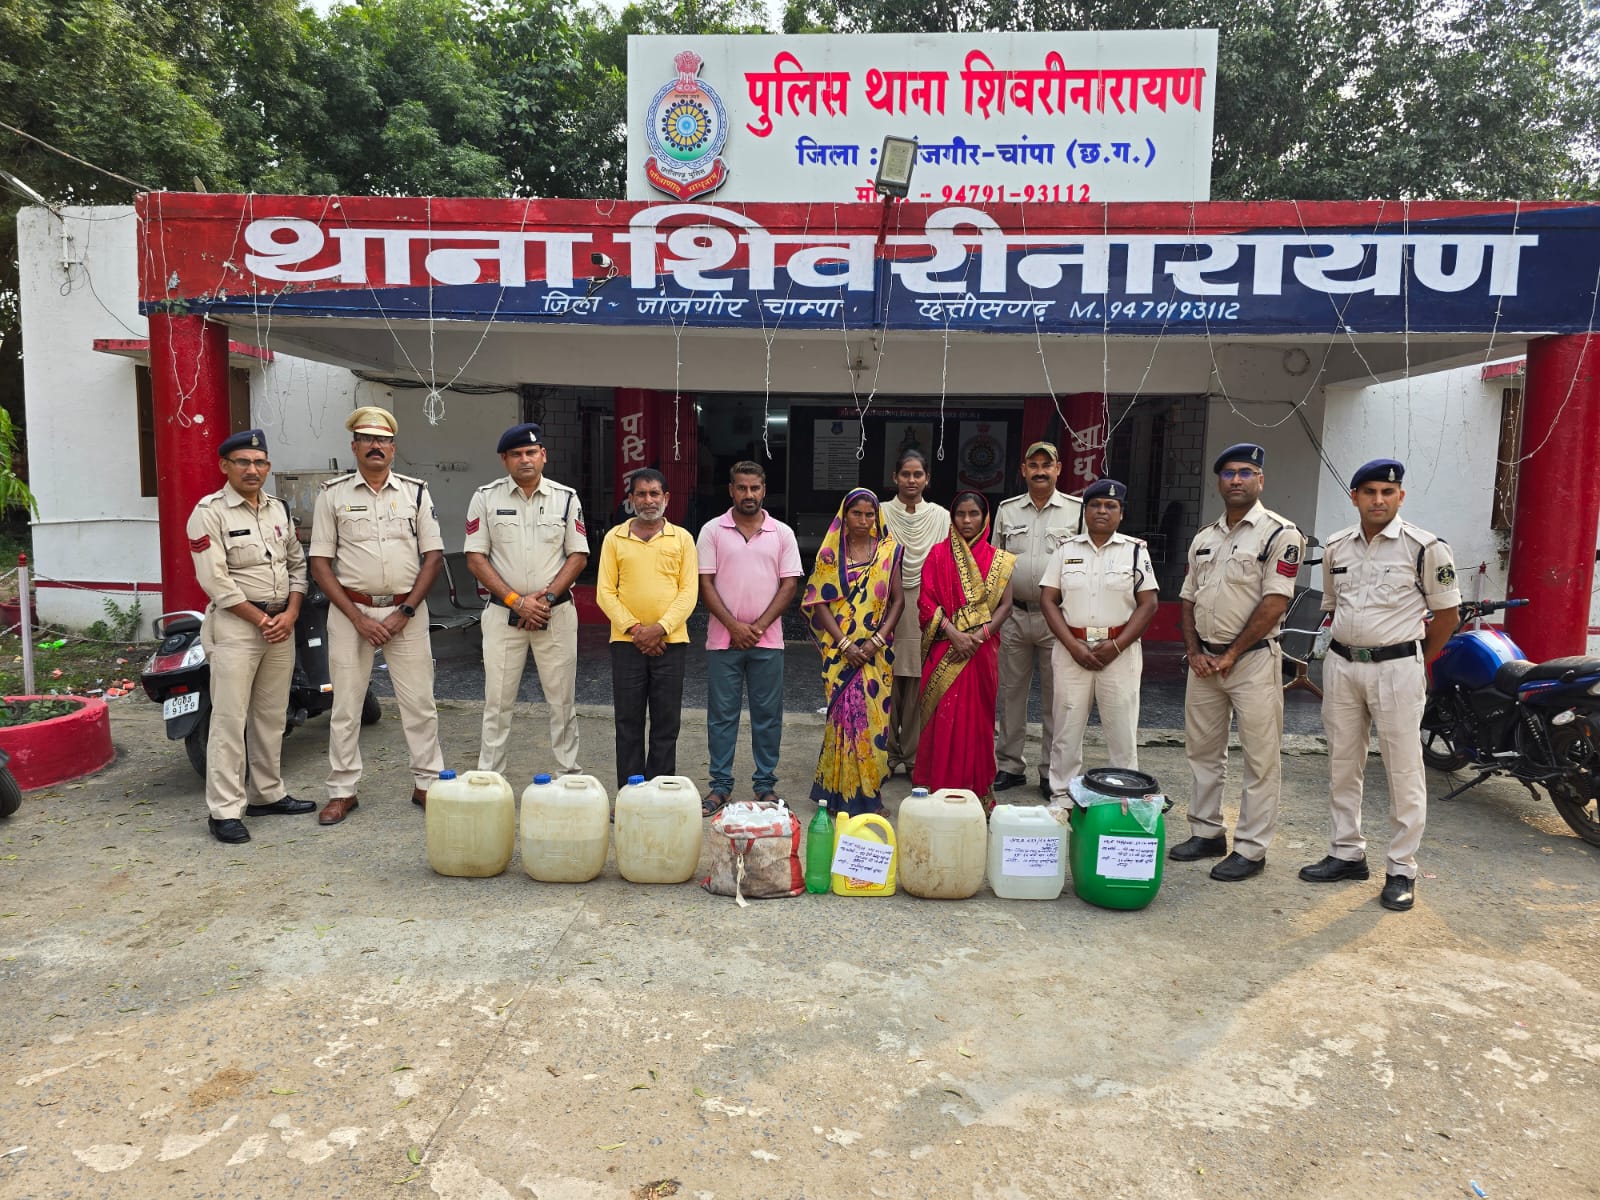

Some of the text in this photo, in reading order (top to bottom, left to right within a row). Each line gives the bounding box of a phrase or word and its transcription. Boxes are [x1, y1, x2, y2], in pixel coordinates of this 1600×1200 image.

[745, 49, 1206, 138] पुलिस थाना शिवरीनारायण
[795, 135, 860, 166] जिला
[913, 134, 1055, 167] ांजगीर-चांपा
[1066, 137, 1157, 169] (छ.ग.)
[941, 184, 1091, 202] 94791-93112
[244, 204, 1539, 297] थाना शिवरीनारायण
[541, 291, 603, 315] जिला
[636, 290, 750, 318] जांजगीर
[763, 297, 845, 319] चाम्पा
